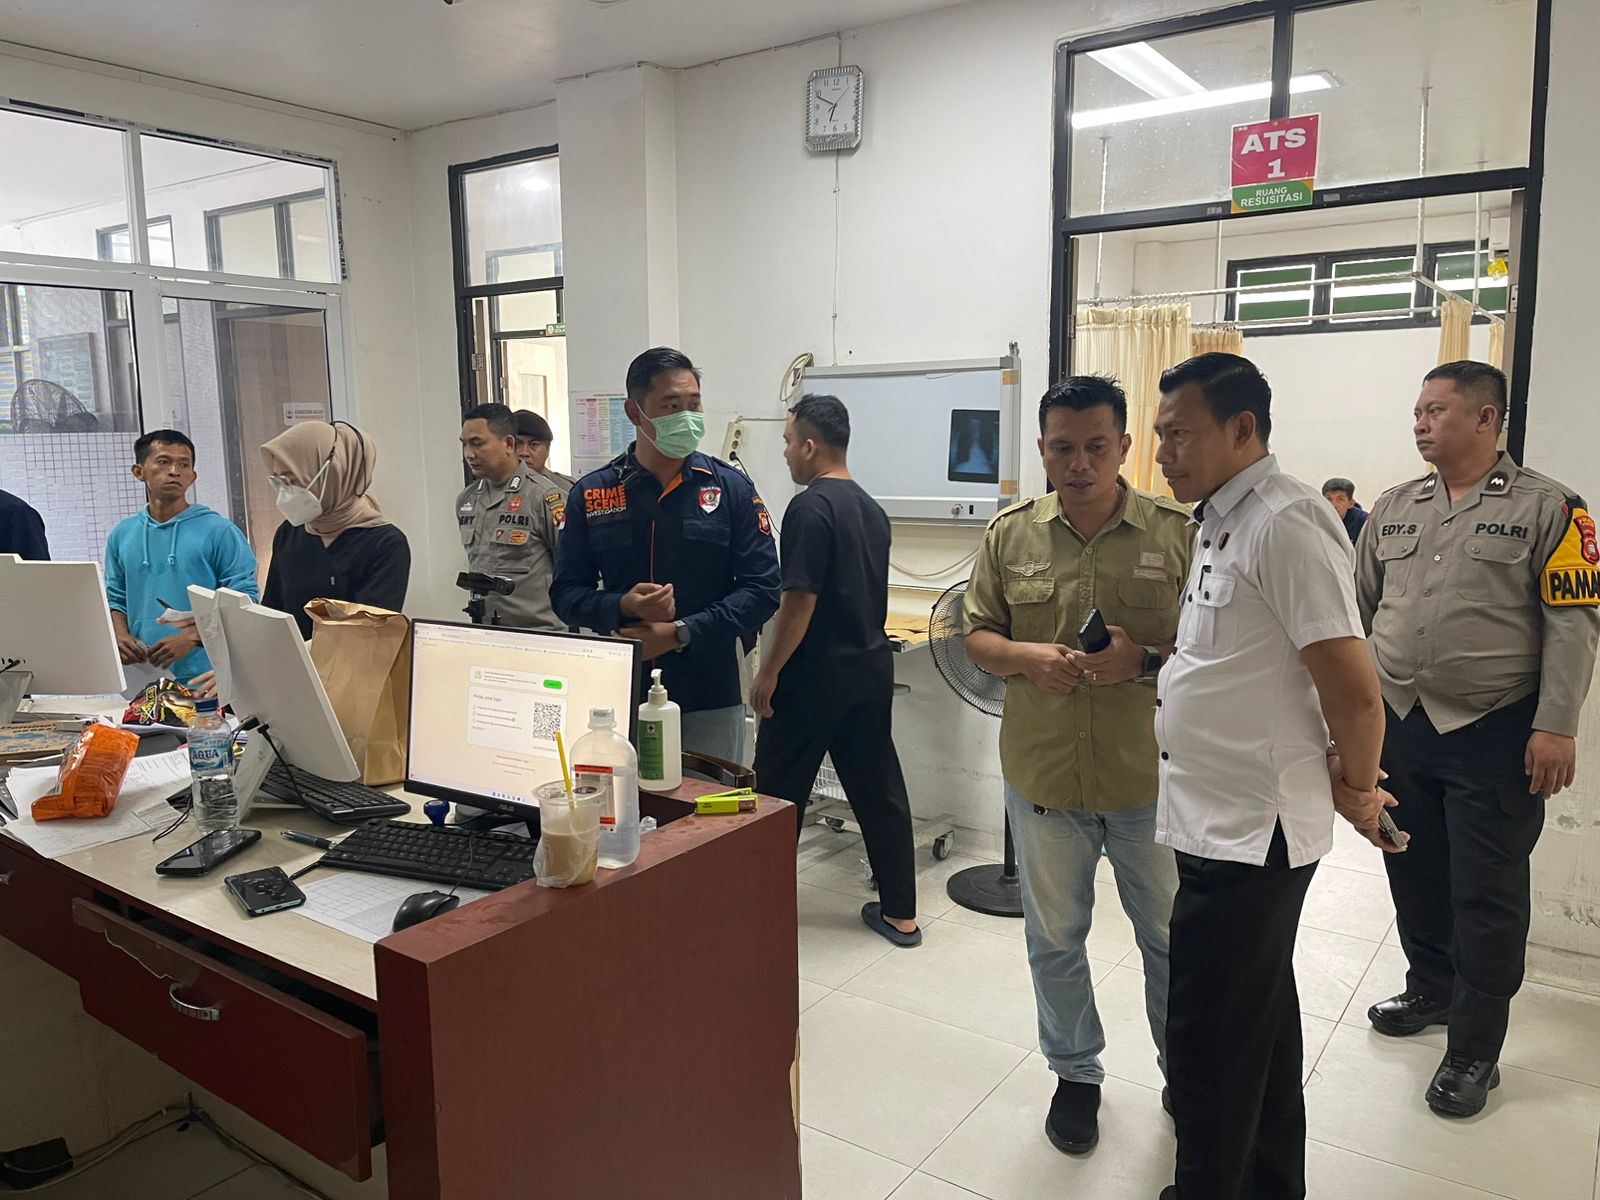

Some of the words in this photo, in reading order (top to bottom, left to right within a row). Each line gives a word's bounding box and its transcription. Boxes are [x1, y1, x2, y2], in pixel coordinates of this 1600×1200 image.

[824, 79, 829, 87] 11
[834, 77, 840, 86] 12
[814, 117, 819, 125] 8
[843, 123, 848, 131] 5
[822, 125, 826, 133] 7
[1241, 128, 1306, 154] ATS
[1268, 159, 1285, 178] 1
[1255, 186, 1288, 197] RUANG
[1241, 192, 1303, 207] RESUSITASI
[583, 485, 626, 500] CRIME
[585, 497, 627, 512] SCENE
[586, 506, 627, 518] INVESTIGATION
[499, 514, 529, 526] POLRI
[1381, 524, 1418, 537] EDY.S
[1475, 523, 1528, 539] POLRI
[192, 749, 219, 760] AQUA
